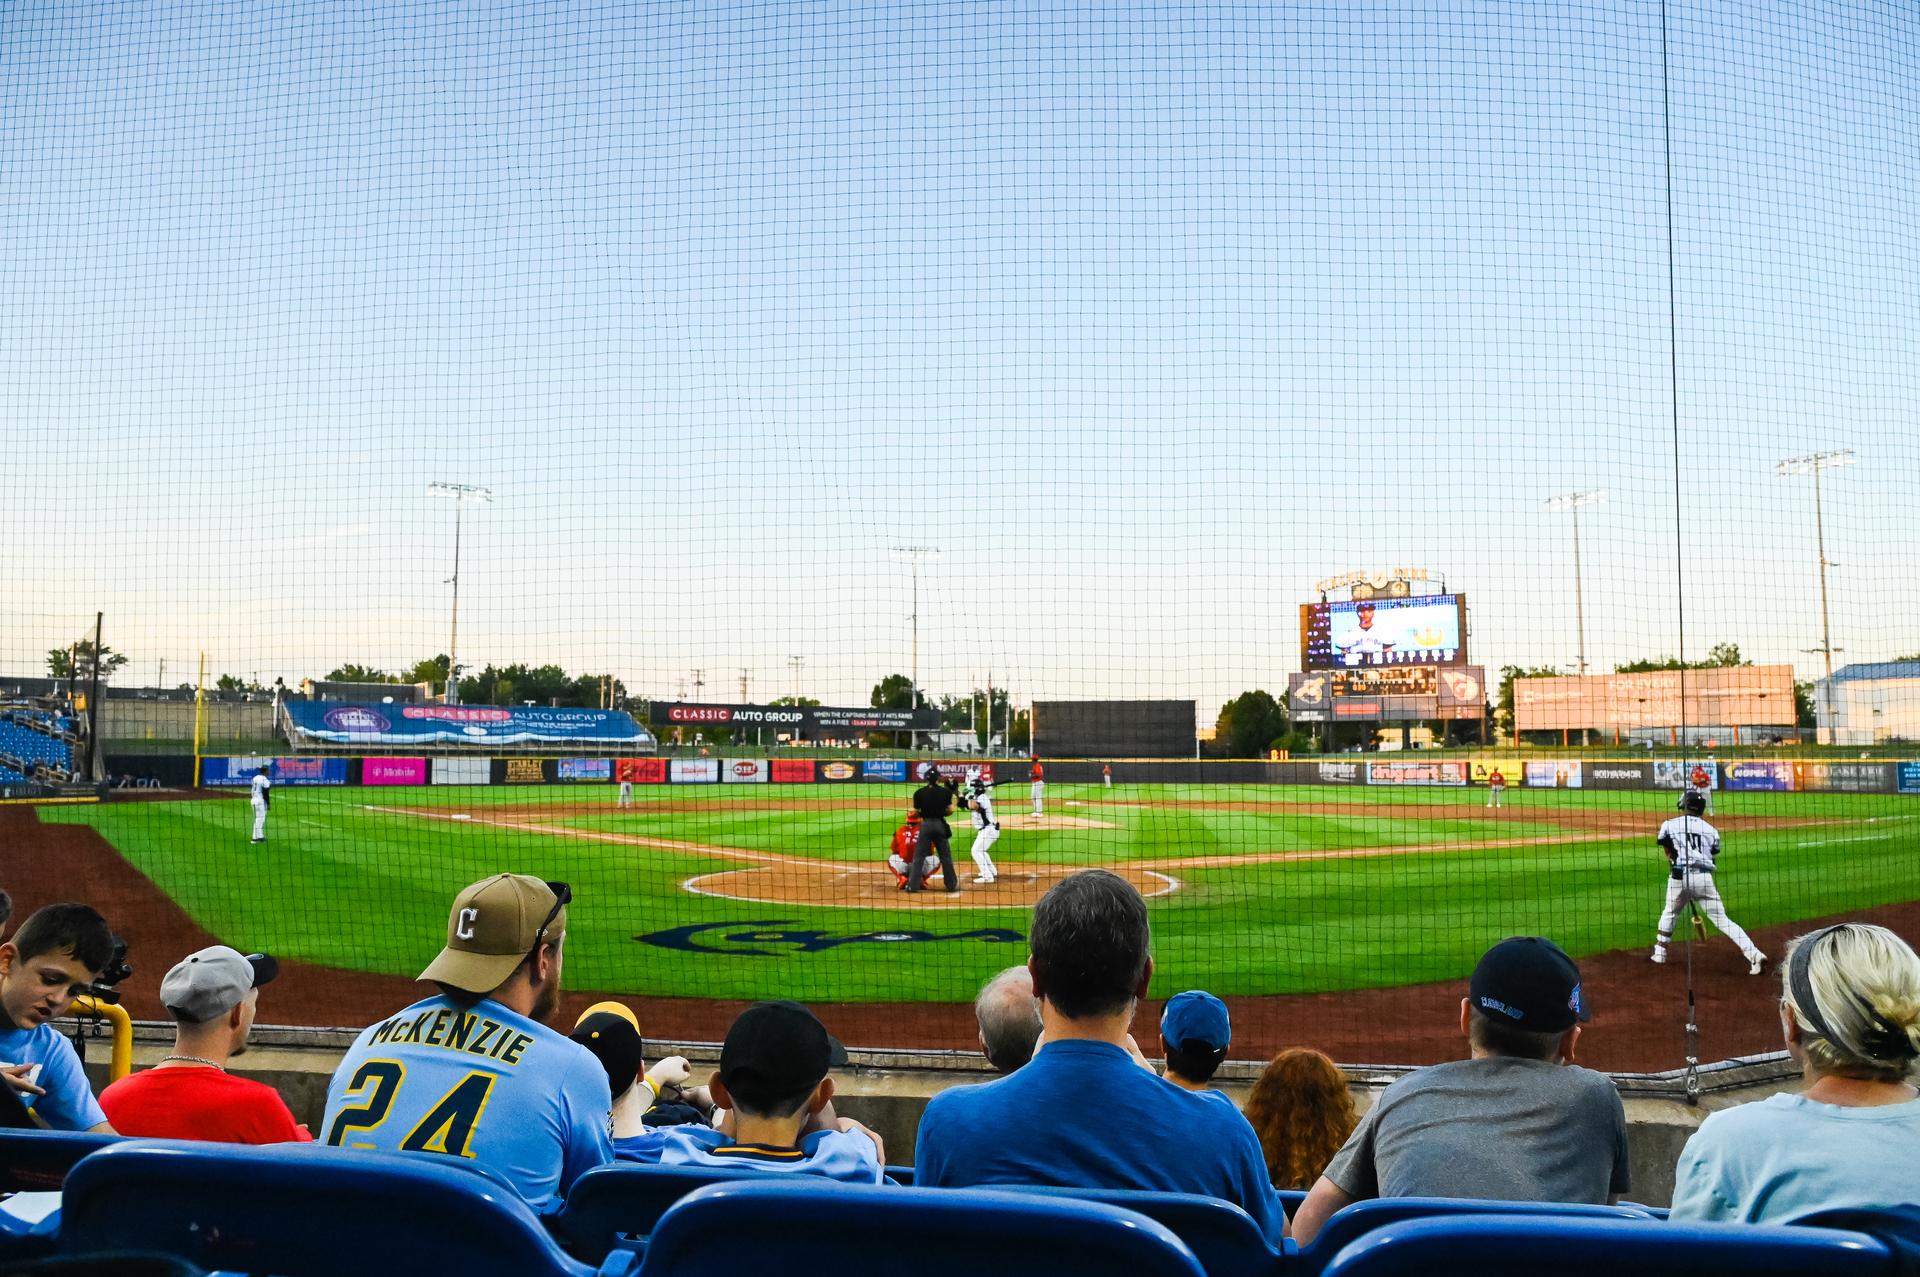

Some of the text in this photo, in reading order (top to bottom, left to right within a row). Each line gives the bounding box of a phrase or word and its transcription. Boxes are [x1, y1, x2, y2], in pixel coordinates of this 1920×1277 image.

[514, 711, 553, 721] AUTO
[556, 713, 607, 722] GROUP
[673, 708, 803, 724] CLASSIC AUTO GROUP
[456, 907, 480, 941] C
[367, 1007, 536, 1067] McKENZIE
[326, 1057, 500, 1160] 24
